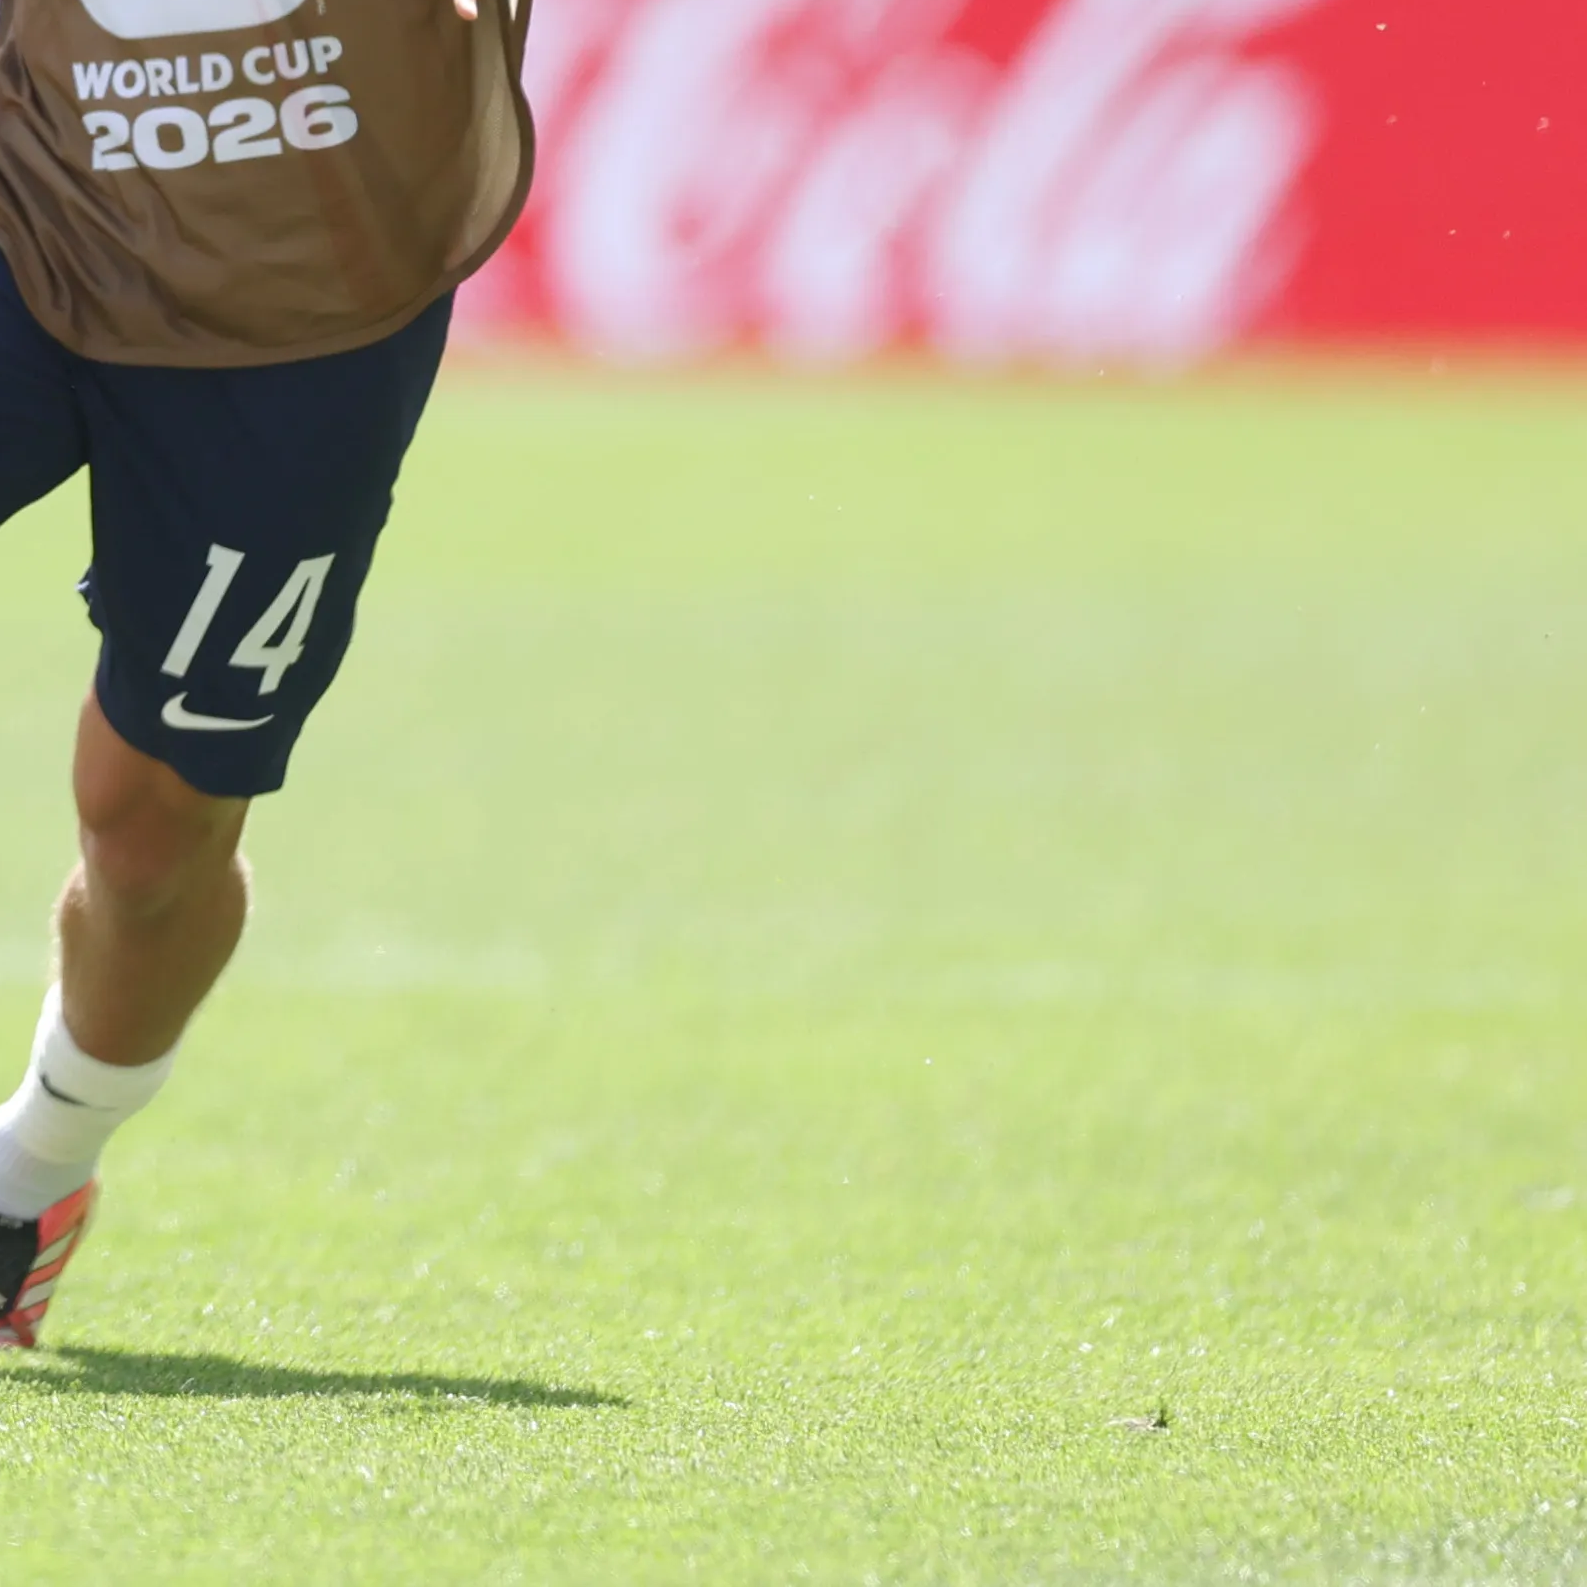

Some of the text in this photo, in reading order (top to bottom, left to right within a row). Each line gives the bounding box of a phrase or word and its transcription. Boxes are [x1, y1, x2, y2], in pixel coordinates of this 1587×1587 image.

[72, 35, 344, 101] WORLD CUP
[82, 84, 359, 172] 2026
[159, 542, 336, 697] 14
